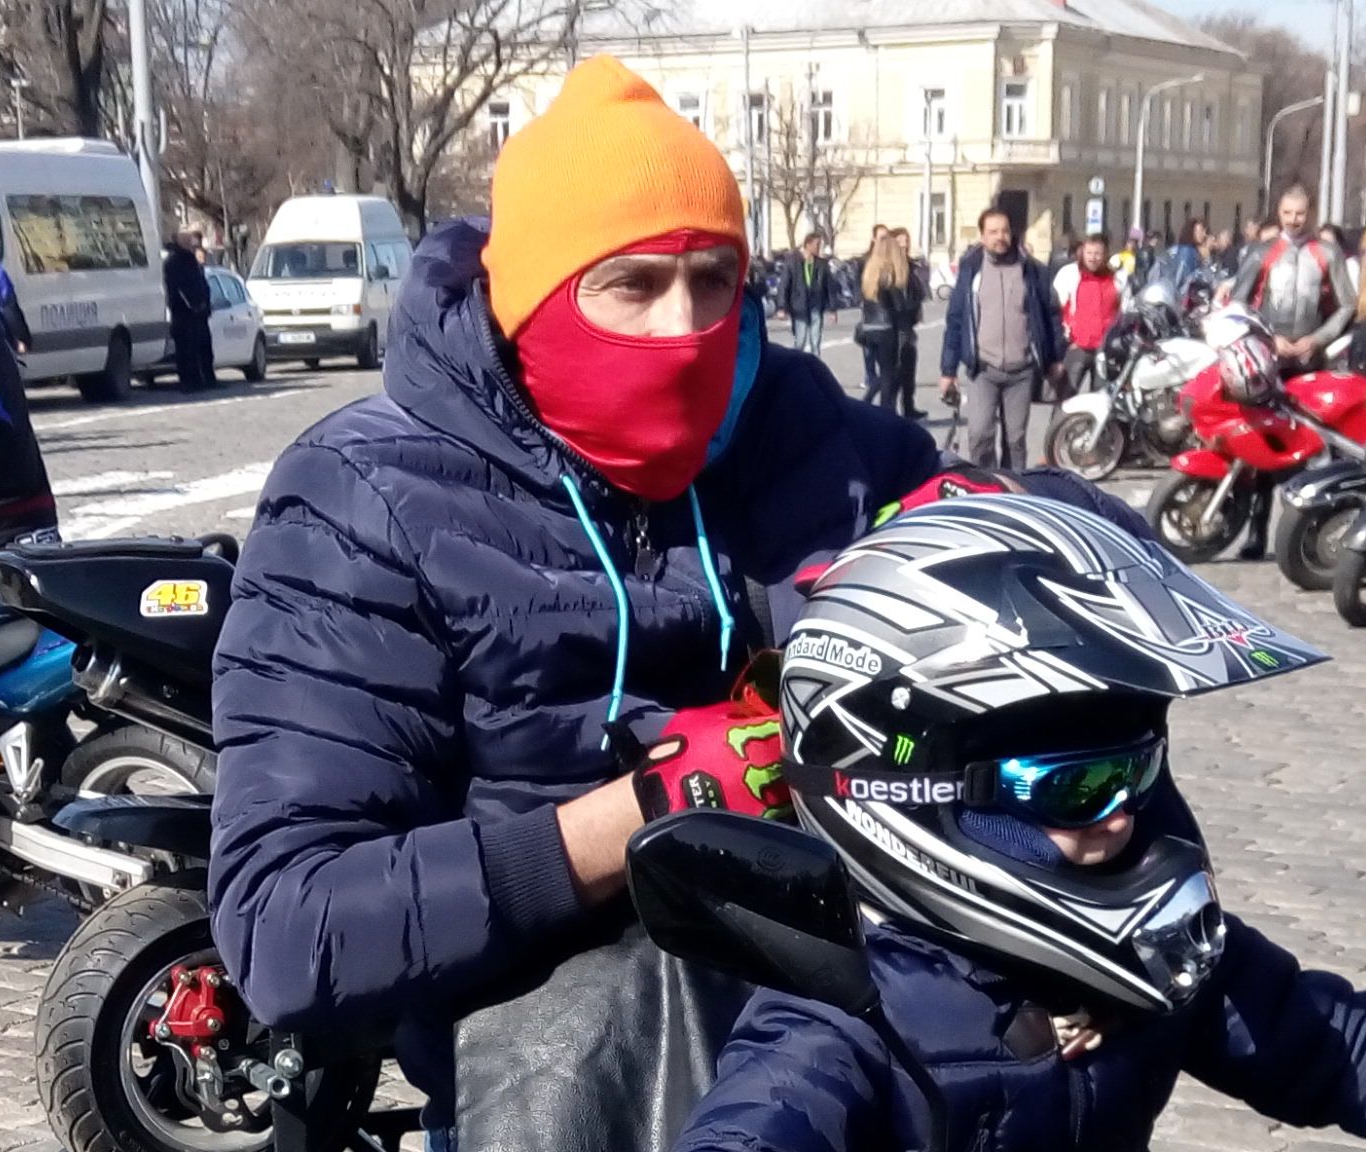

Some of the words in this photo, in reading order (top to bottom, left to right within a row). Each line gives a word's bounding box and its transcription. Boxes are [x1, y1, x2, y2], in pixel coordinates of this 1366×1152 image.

[146, 581, 202, 607] 46
[827, 638, 882, 675] Mode
[834, 770, 966, 804] koestler
